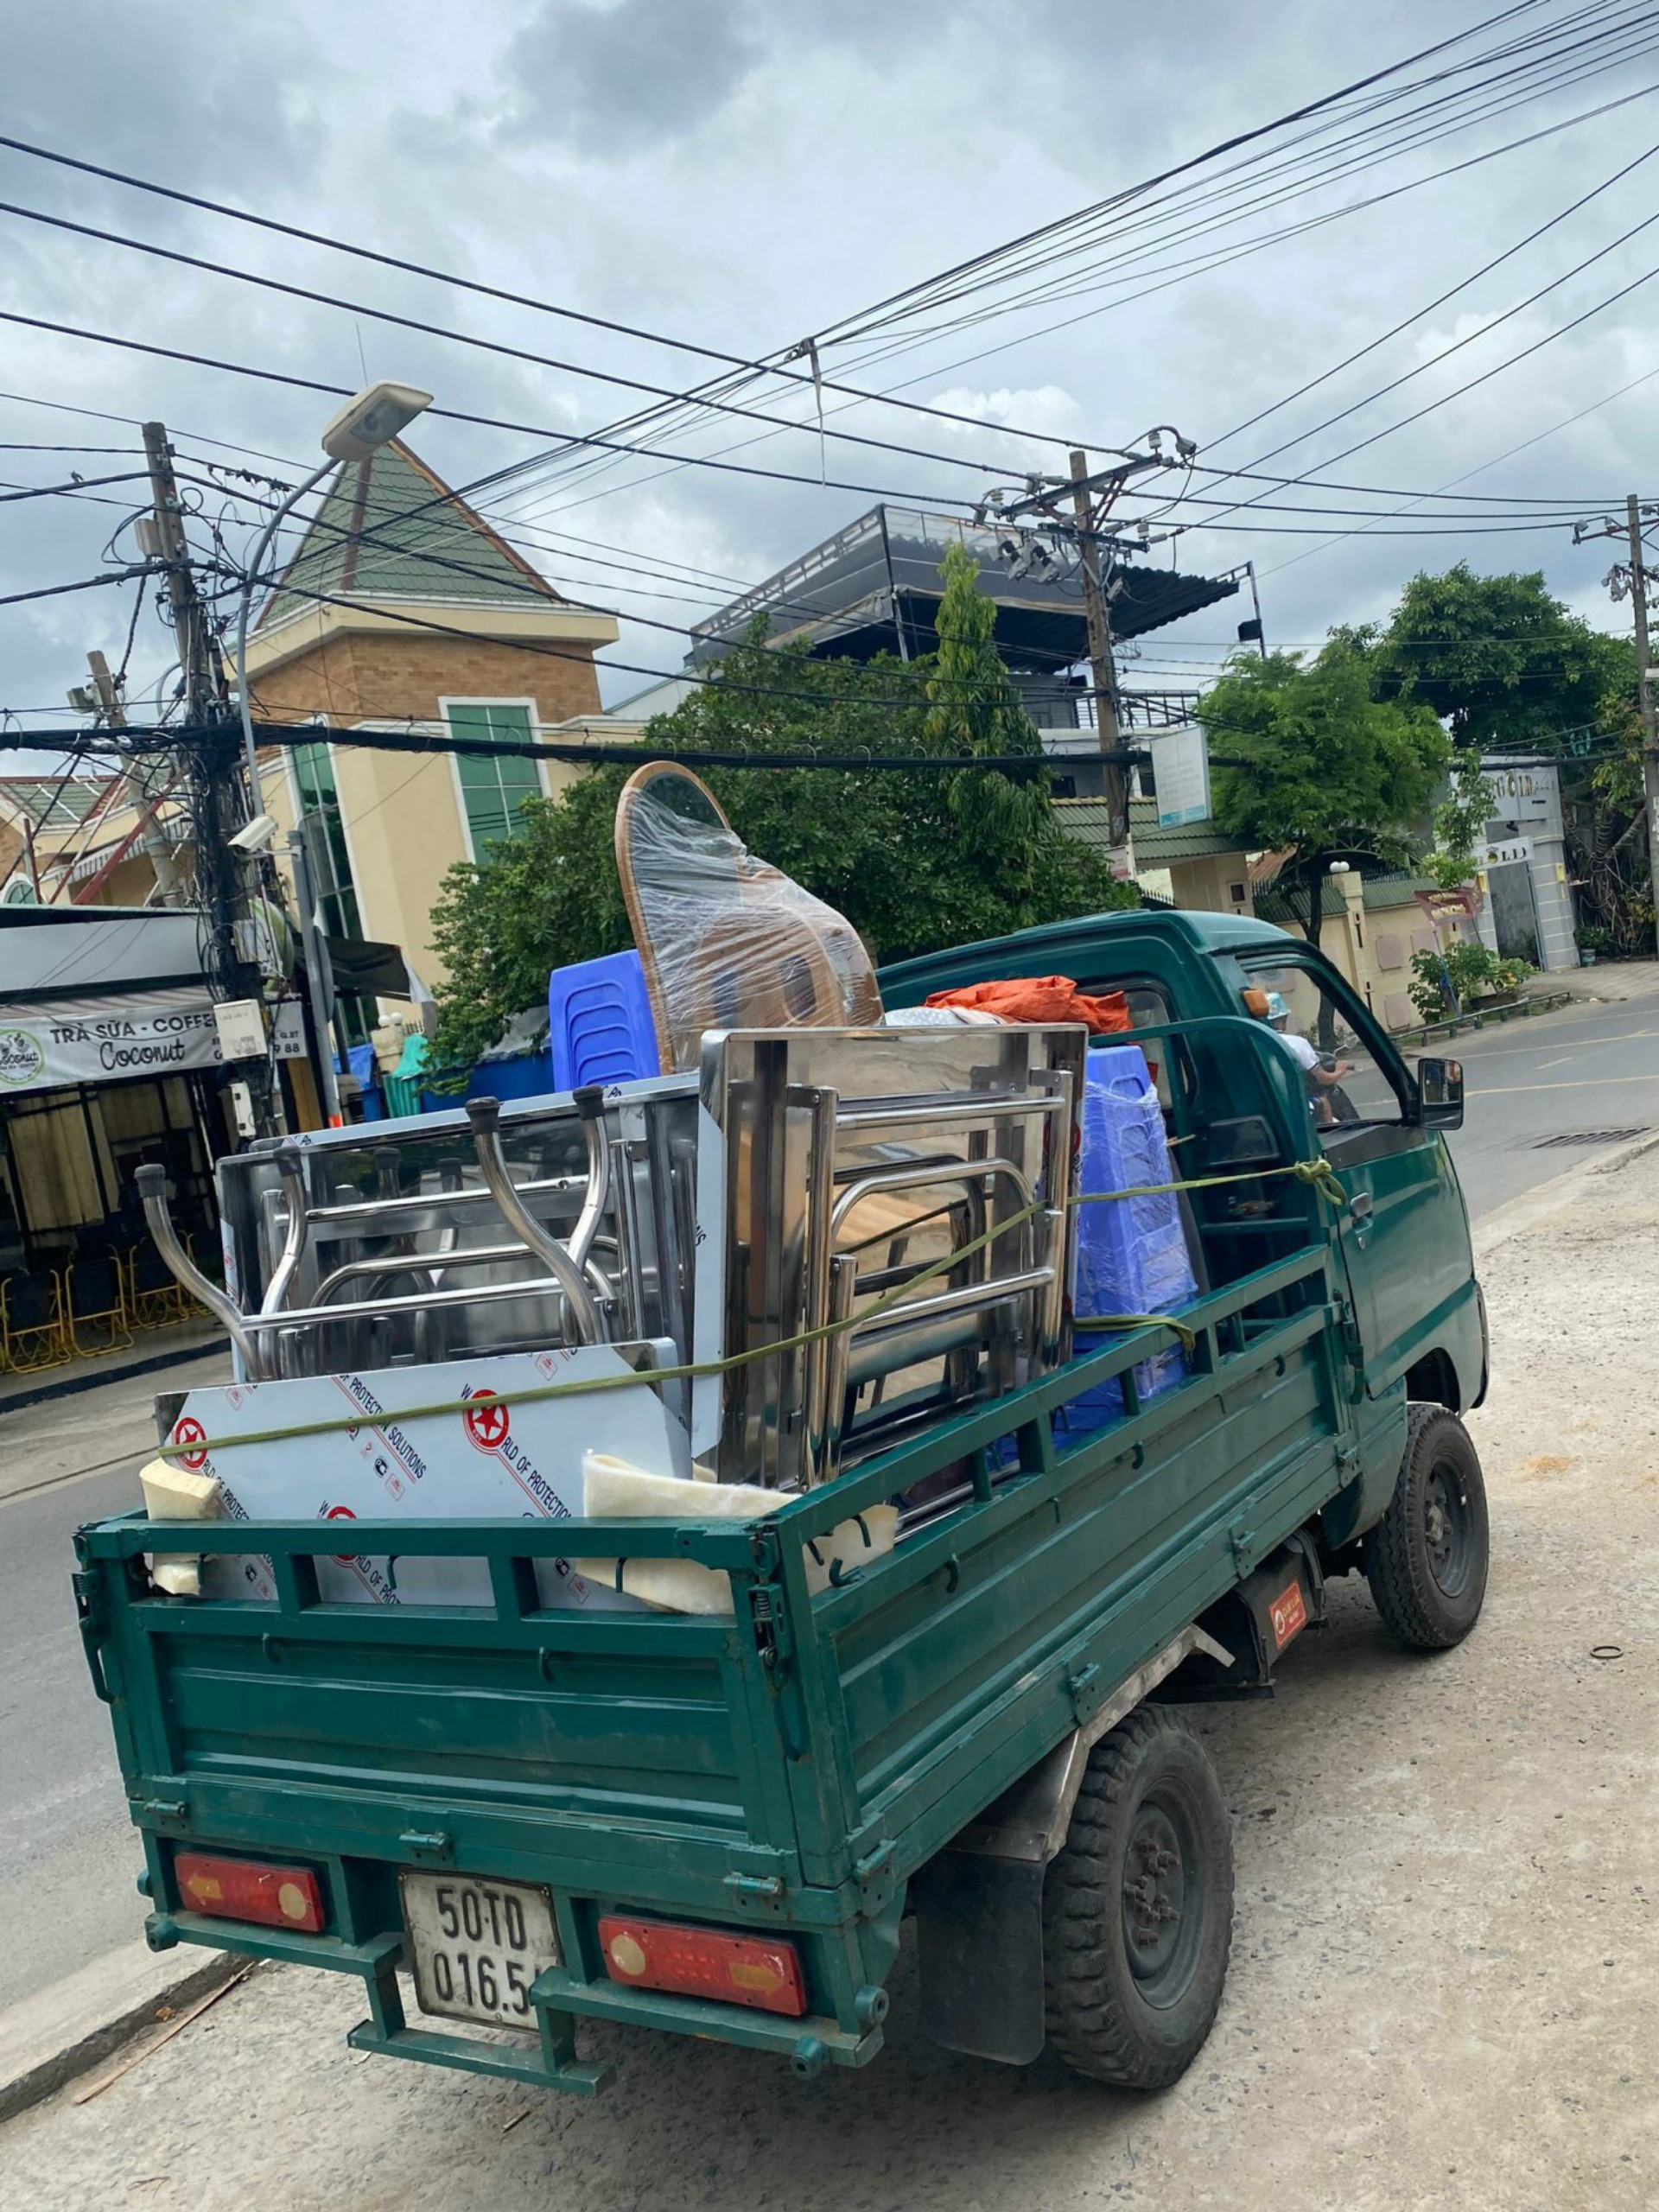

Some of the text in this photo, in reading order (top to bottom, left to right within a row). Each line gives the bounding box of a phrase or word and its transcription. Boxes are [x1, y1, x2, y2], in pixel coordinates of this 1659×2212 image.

[50, 1022, 90, 1044] TRÀ
[96, 1020, 136, 1039] SỮA
[152, 1014, 216, 1033] COFFE
[100, 1038, 185, 1071] Coconut
[350, 1376, 391, 1433] PROTECTN
[388, 1427, 427, 1478] SOLUTIONS
[517, 1456, 531, 1474] OF
[527, 1470, 572, 1519] PROTECTIO
[370, 1570, 383, 1586] OF
[434, 1952, 541, 2015] 016.5
